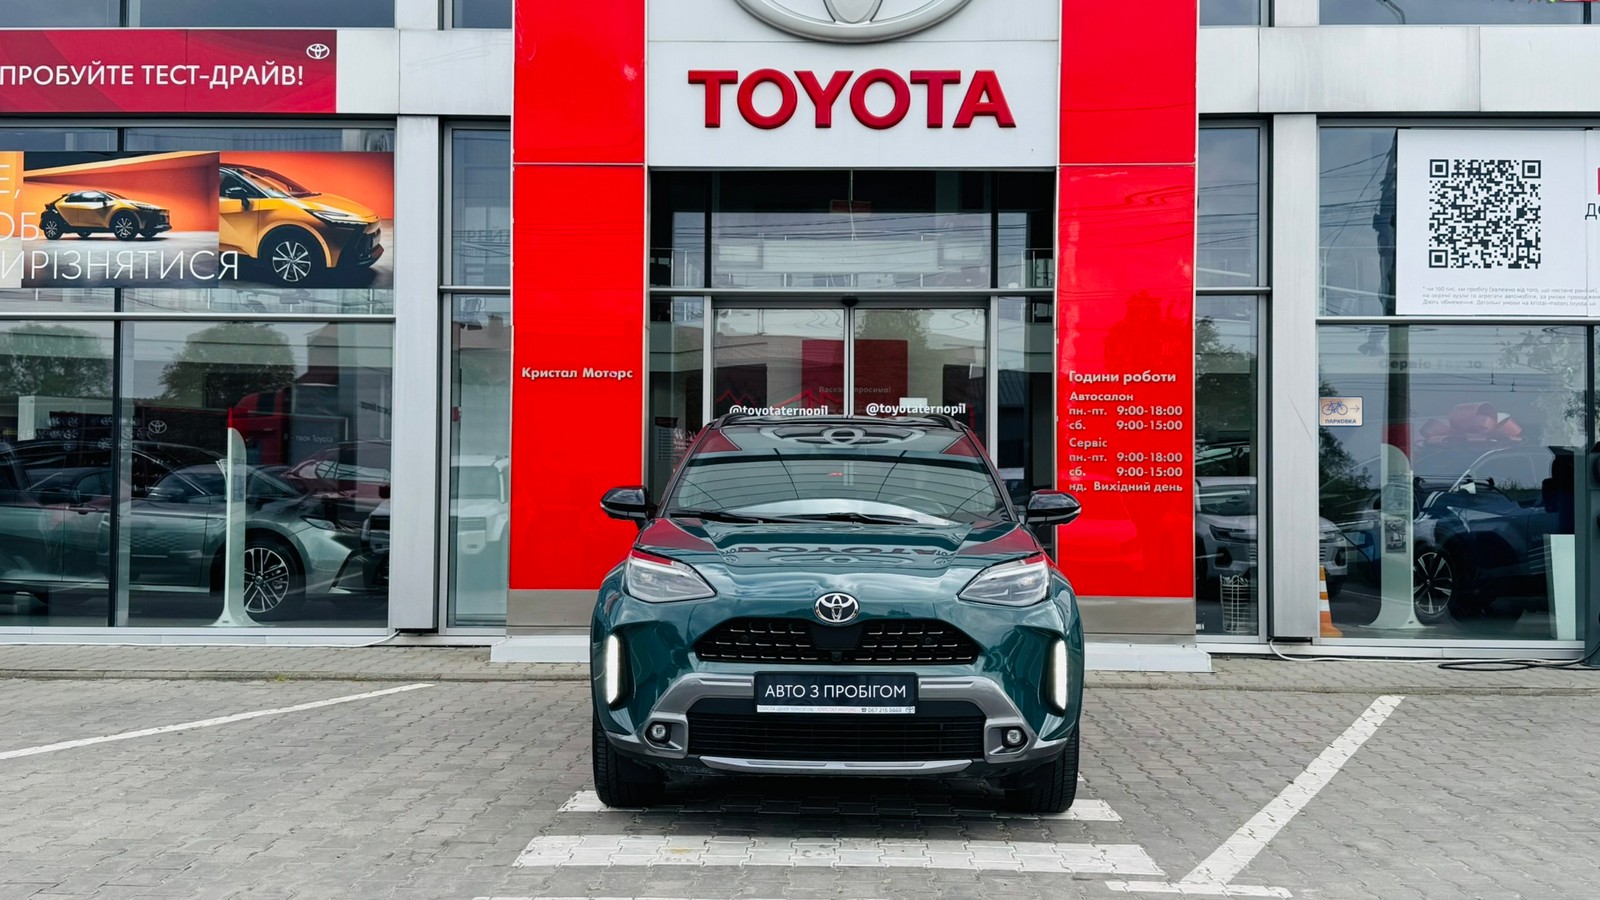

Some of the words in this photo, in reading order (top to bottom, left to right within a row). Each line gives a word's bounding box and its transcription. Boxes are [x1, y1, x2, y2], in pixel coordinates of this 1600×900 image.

[0, 60, 134, 86] ПРОБУЙТЕ
[141, 60, 304, 89] ТЕСТ-ДРАЙВ!
[688, 68, 1017, 130] TOYOTA
[1584, 202, 1600, 220] Д
[521, 366, 578, 381] Кристал
[582, 367, 634, 381] Моторс
[1069, 370, 1120, 384] Години
[1123, 370, 1177, 386] роботи
[1069, 391, 1134, 401] Автосалон
[866, 402, 966, 417] @toyotaternopil
[1068, 407, 1108, 416] пн.-пт.
[1068, 419, 1087, 430] сб.
[1068, 437, 1108, 450] Сервіс
[1068, 453, 1108, 462] пн.-пт.
[1068, 466, 1087, 477] сб.
[1068, 483, 1088, 492] нд.
[1093, 480, 1151, 492] Вихідний
[1153, 483, 1183, 492] день
[764, 684, 806, 698] АВТО
[810, 684, 820, 698] З
[823, 684, 906, 699] ПРОБІГОМ
